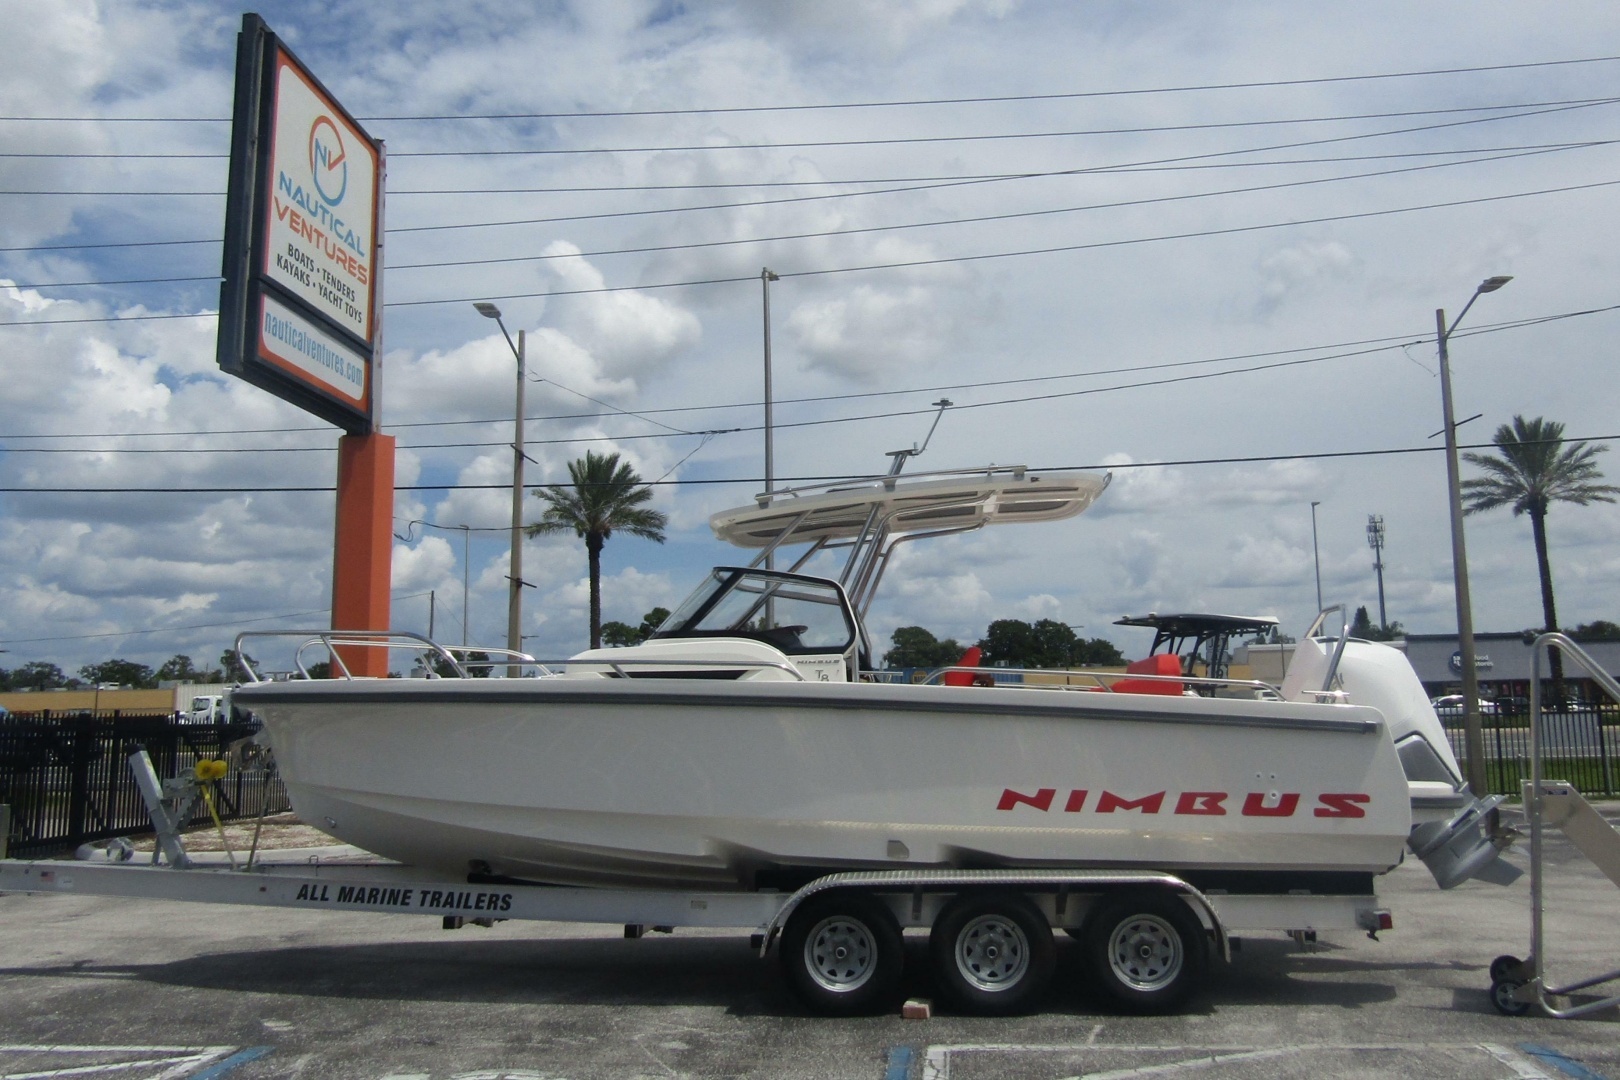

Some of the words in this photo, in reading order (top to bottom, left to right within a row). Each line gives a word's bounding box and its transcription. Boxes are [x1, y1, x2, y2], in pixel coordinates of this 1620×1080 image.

[273, 195, 368, 286] VENTURES
[279, 170, 365, 257] NAUTICAL
[276, 253, 311, 288] KAYAKS
[318, 282, 343, 310] YACHT
[345, 301, 363, 324] TOYS
[287, 242, 315, 273] BOATS
[322, 268, 355, 303] TENDERS
[264, 311, 363, 387] nauticalventures.com
[996, 788, 1371, 819] NIMBUS
[296, 884, 330, 902] ALL
[337, 886, 414, 906] MARINE
[419, 890, 513, 912] TRAILERS
